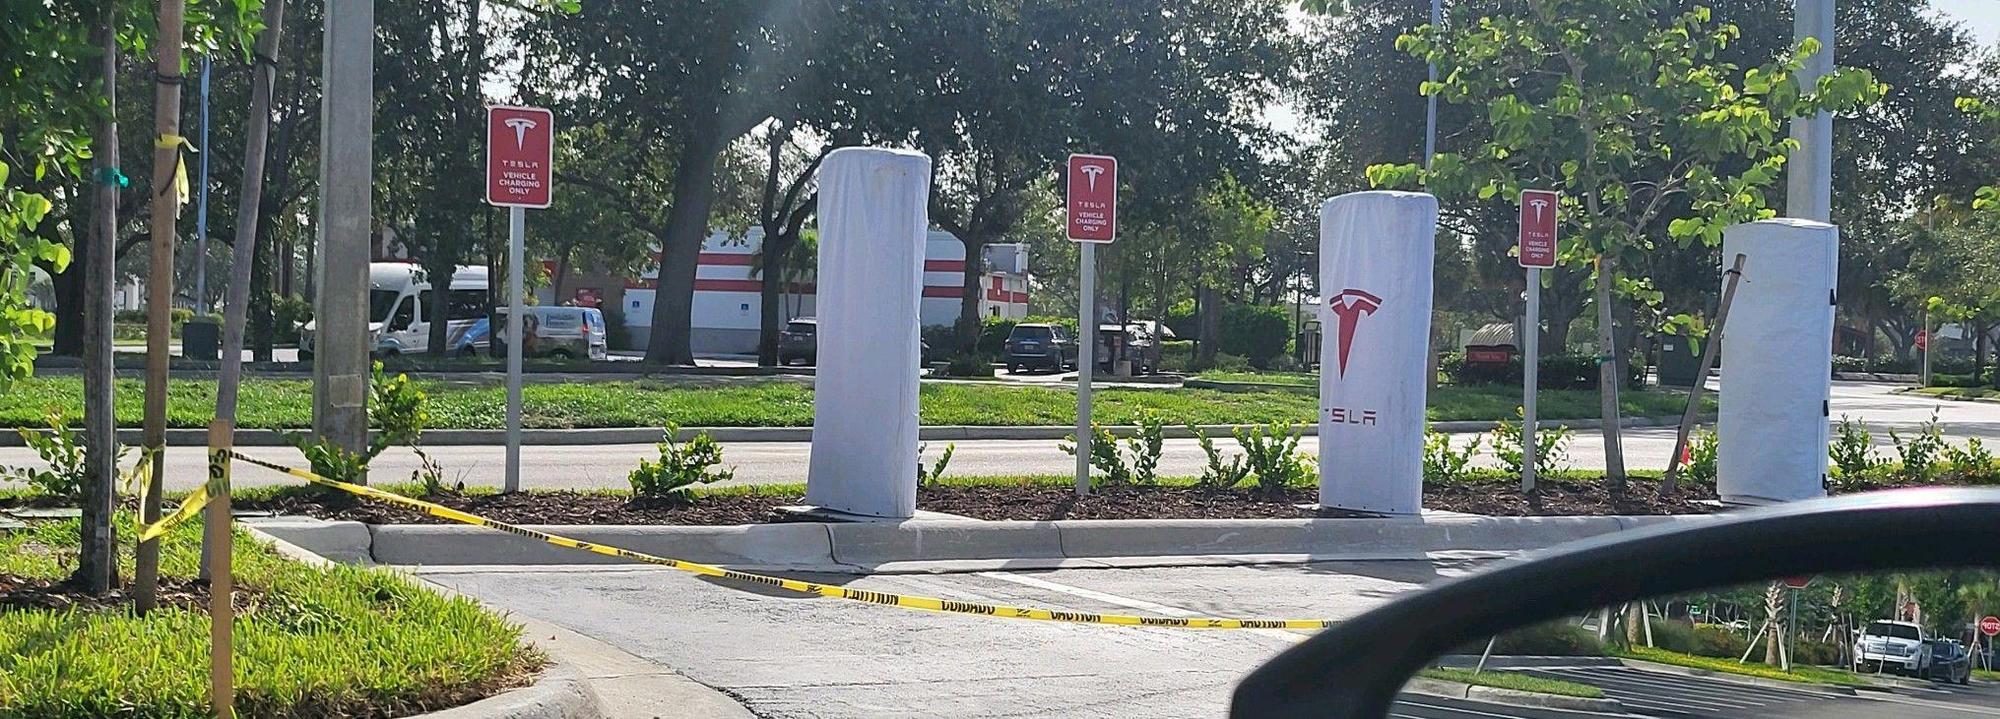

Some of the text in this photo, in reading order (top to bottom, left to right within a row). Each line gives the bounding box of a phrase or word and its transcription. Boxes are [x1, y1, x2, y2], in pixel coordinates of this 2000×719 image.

[502, 160, 539, 169] TESLA
[503, 171, 536, 180] VEHICLE
[499, 179, 540, 188] CHARGING
[509, 187, 530, 195] ONLY
[1078, 201, 1106, 209] TESLA
[1079, 211, 1104, 219] VEHICLE
[1075, 218, 1107, 226] CHARGING
